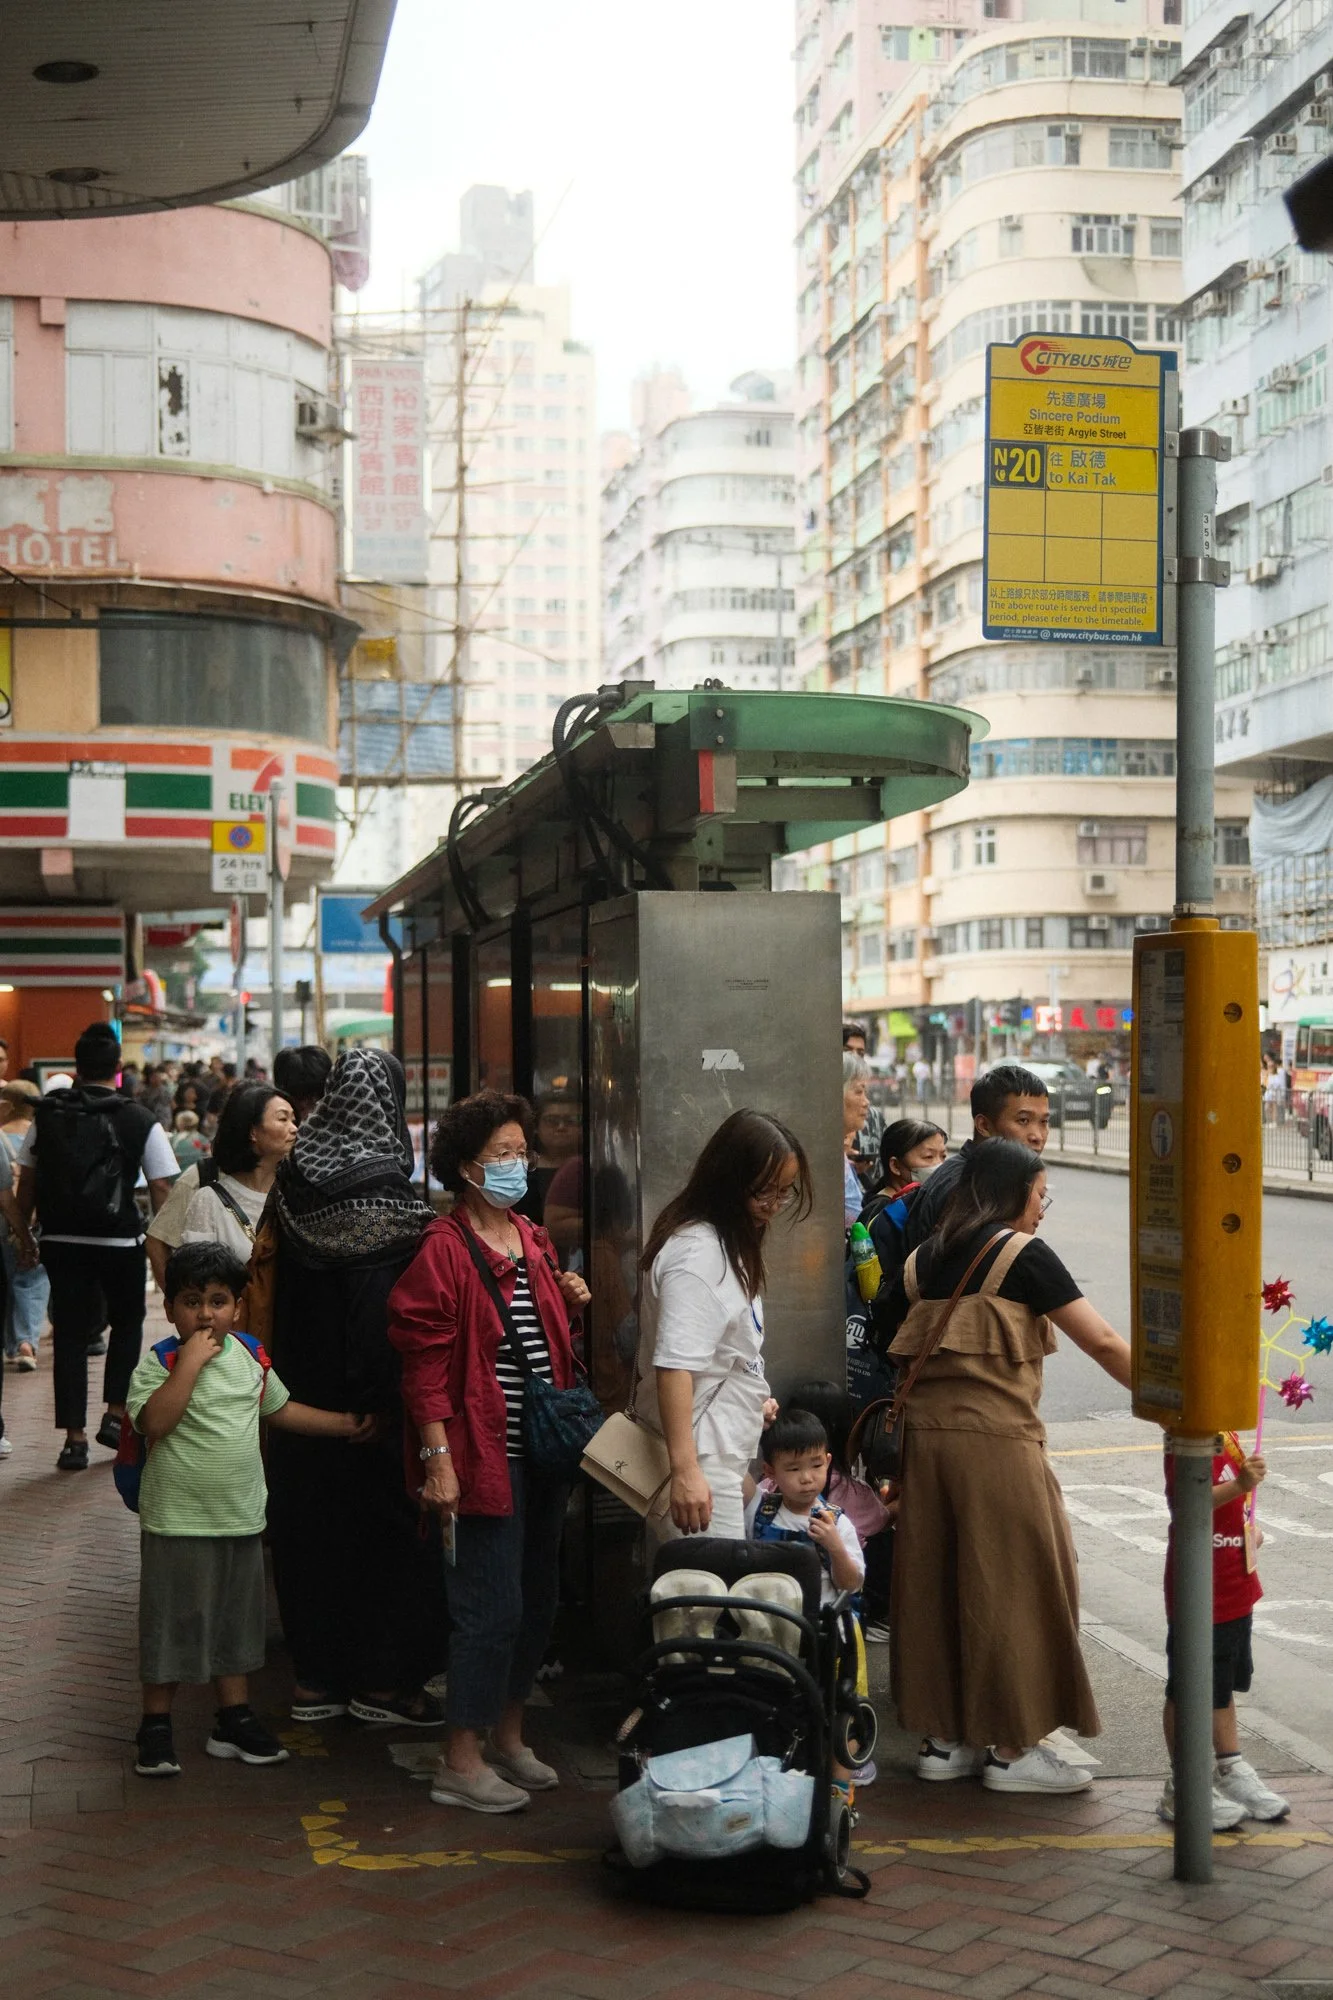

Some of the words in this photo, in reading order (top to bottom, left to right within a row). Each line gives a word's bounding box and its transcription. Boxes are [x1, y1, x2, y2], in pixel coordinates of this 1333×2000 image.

[1036, 351, 1102, 368] CITYBUS
[1102, 354, 1132, 370] 城巴
[1046, 390, 1106, 410] 先達廣場
[1029, 408, 1073, 423] Sincere
[1076, 411, 1121, 425] Podium
[1023, 423, 1065, 437] 亞皆老街
[1068, 427, 1098, 439] Argyle
[1100, 428, 1127, 439] Street
[994, 447, 1041, 484] N20
[1050, 451, 1063, 467] 往
[1050, 472, 1063, 483] to
[1068, 472, 1088, 485] Kai
[1093, 473, 1117, 486] Tak
[990, 600, 1005, 610] The
[1007, 601, 1034, 611] above
[1036, 602, 1059, 611] route
[1061, 602, 1068, 612] is
[1070, 603, 1097, 613] served
[1100, 604, 1108, 613] in
[1110, 604, 1147, 616] specified
[1022, 613, 1049, 624] please
[1051, 614, 1072, 623] refer
[1074, 615, 1083, 624] to
[1085, 615, 1099, 625] the
[1101, 616, 1144, 626] timetable.
[1053, 630, 1142, 642] www.citybus.com.hk
[219, 857, 237, 869] 24
[241, 858, 262, 869] hrs
[223, 871, 257, 888] 全日
